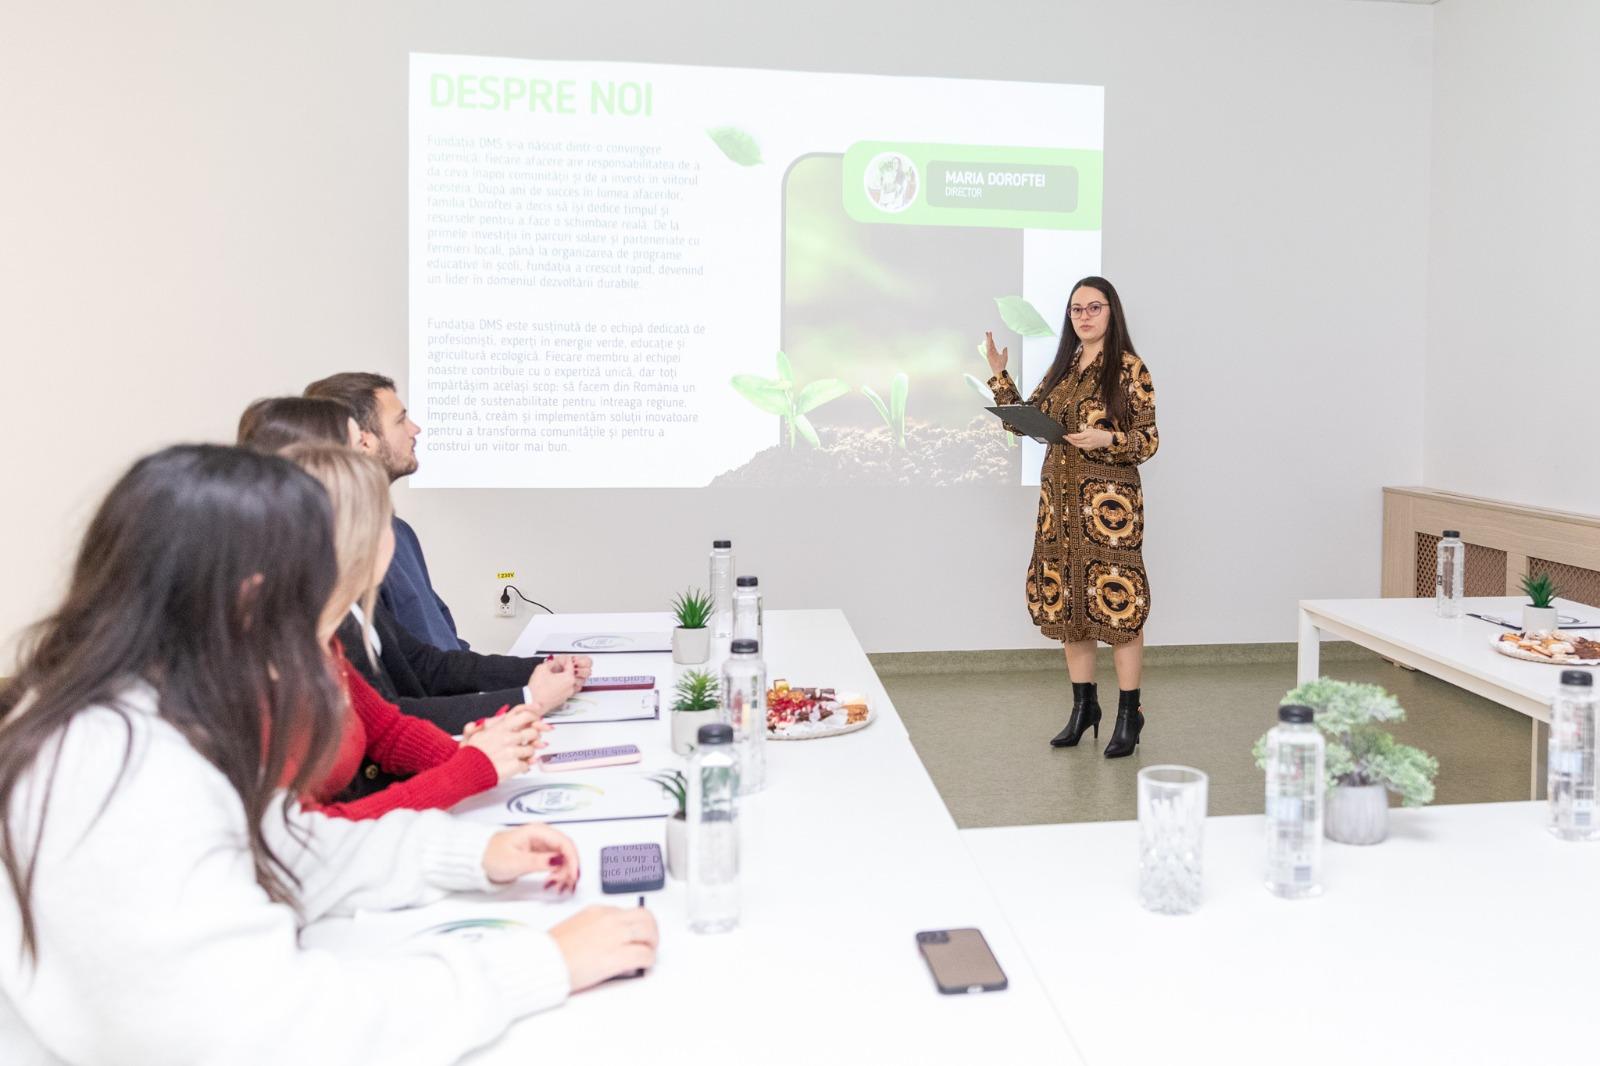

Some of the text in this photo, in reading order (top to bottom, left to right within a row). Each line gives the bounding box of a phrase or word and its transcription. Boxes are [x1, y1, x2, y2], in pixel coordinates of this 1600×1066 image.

[429, 73, 653, 117] DESPRE NOI
[945, 170, 1045, 187] MARIA DOROFTEI
[945, 187, 983, 198] DIRECTOR
[479, 320, 502, 330] DMS
[506, 321, 528, 331] este
[584, 322, 597, 332] de
[693, 324, 706, 334] de
[554, 337, 592, 349] energie
[596, 337, 626, 349] verde,
[545, 351, 582, 362] Fiecare
[586, 352, 628, 362] membru
[633, 352, 642, 362] al
[645, 352, 681, 365] echipei
[427, 365, 467, 375] noastre
[471, 365, 524, 376] contribuie
[528, 368, 540, 376] cu
[639, 367, 655, 377] dar
[578, 381, 609, 392] facem
[613, 382, 629, 392] din
[427, 396, 460, 406] model
[463, 396, 476, 406] de
[480, 396, 558, 406] sustenabilitate
[562, 397, 595, 409] pentru
[645, 412, 698, 422] inovatoare
[427, 426, 462, 438] pentru
[476, 426, 536, 436] transforma
[621, 427, 654, 439] pentru
[427, 441, 470, 451] construi
[492, 442, 518, 451] viitor
[524, 442, 543, 451] mai
[547, 441, 571, 451] bun.
